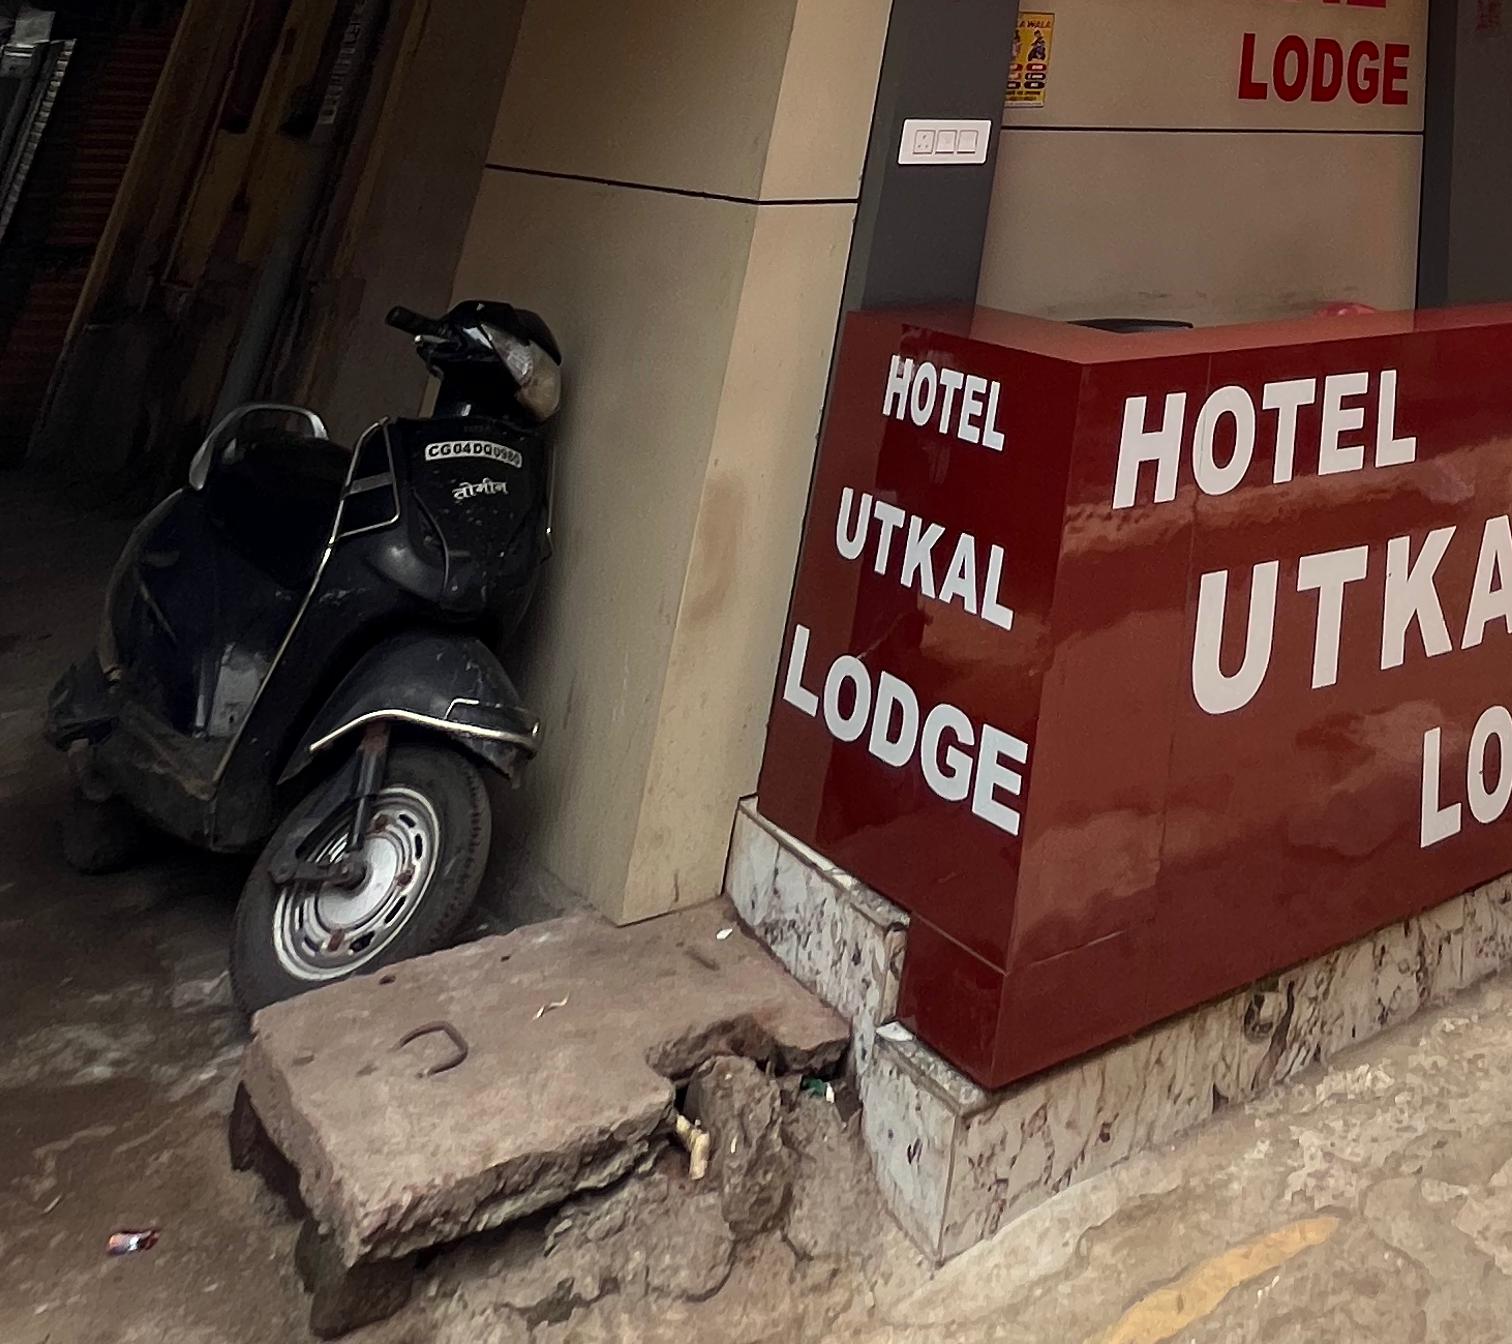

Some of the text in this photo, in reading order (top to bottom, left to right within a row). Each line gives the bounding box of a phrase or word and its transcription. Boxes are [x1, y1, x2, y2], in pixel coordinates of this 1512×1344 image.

[1238, 33, 1411, 106] LODGE
[882, 353, 1006, 452] HOTEL
[1112, 369, 1417, 510] HOTEL
[834, 487, 1014, 632] UTKAL
[782, 624, 1029, 837] LODGE
